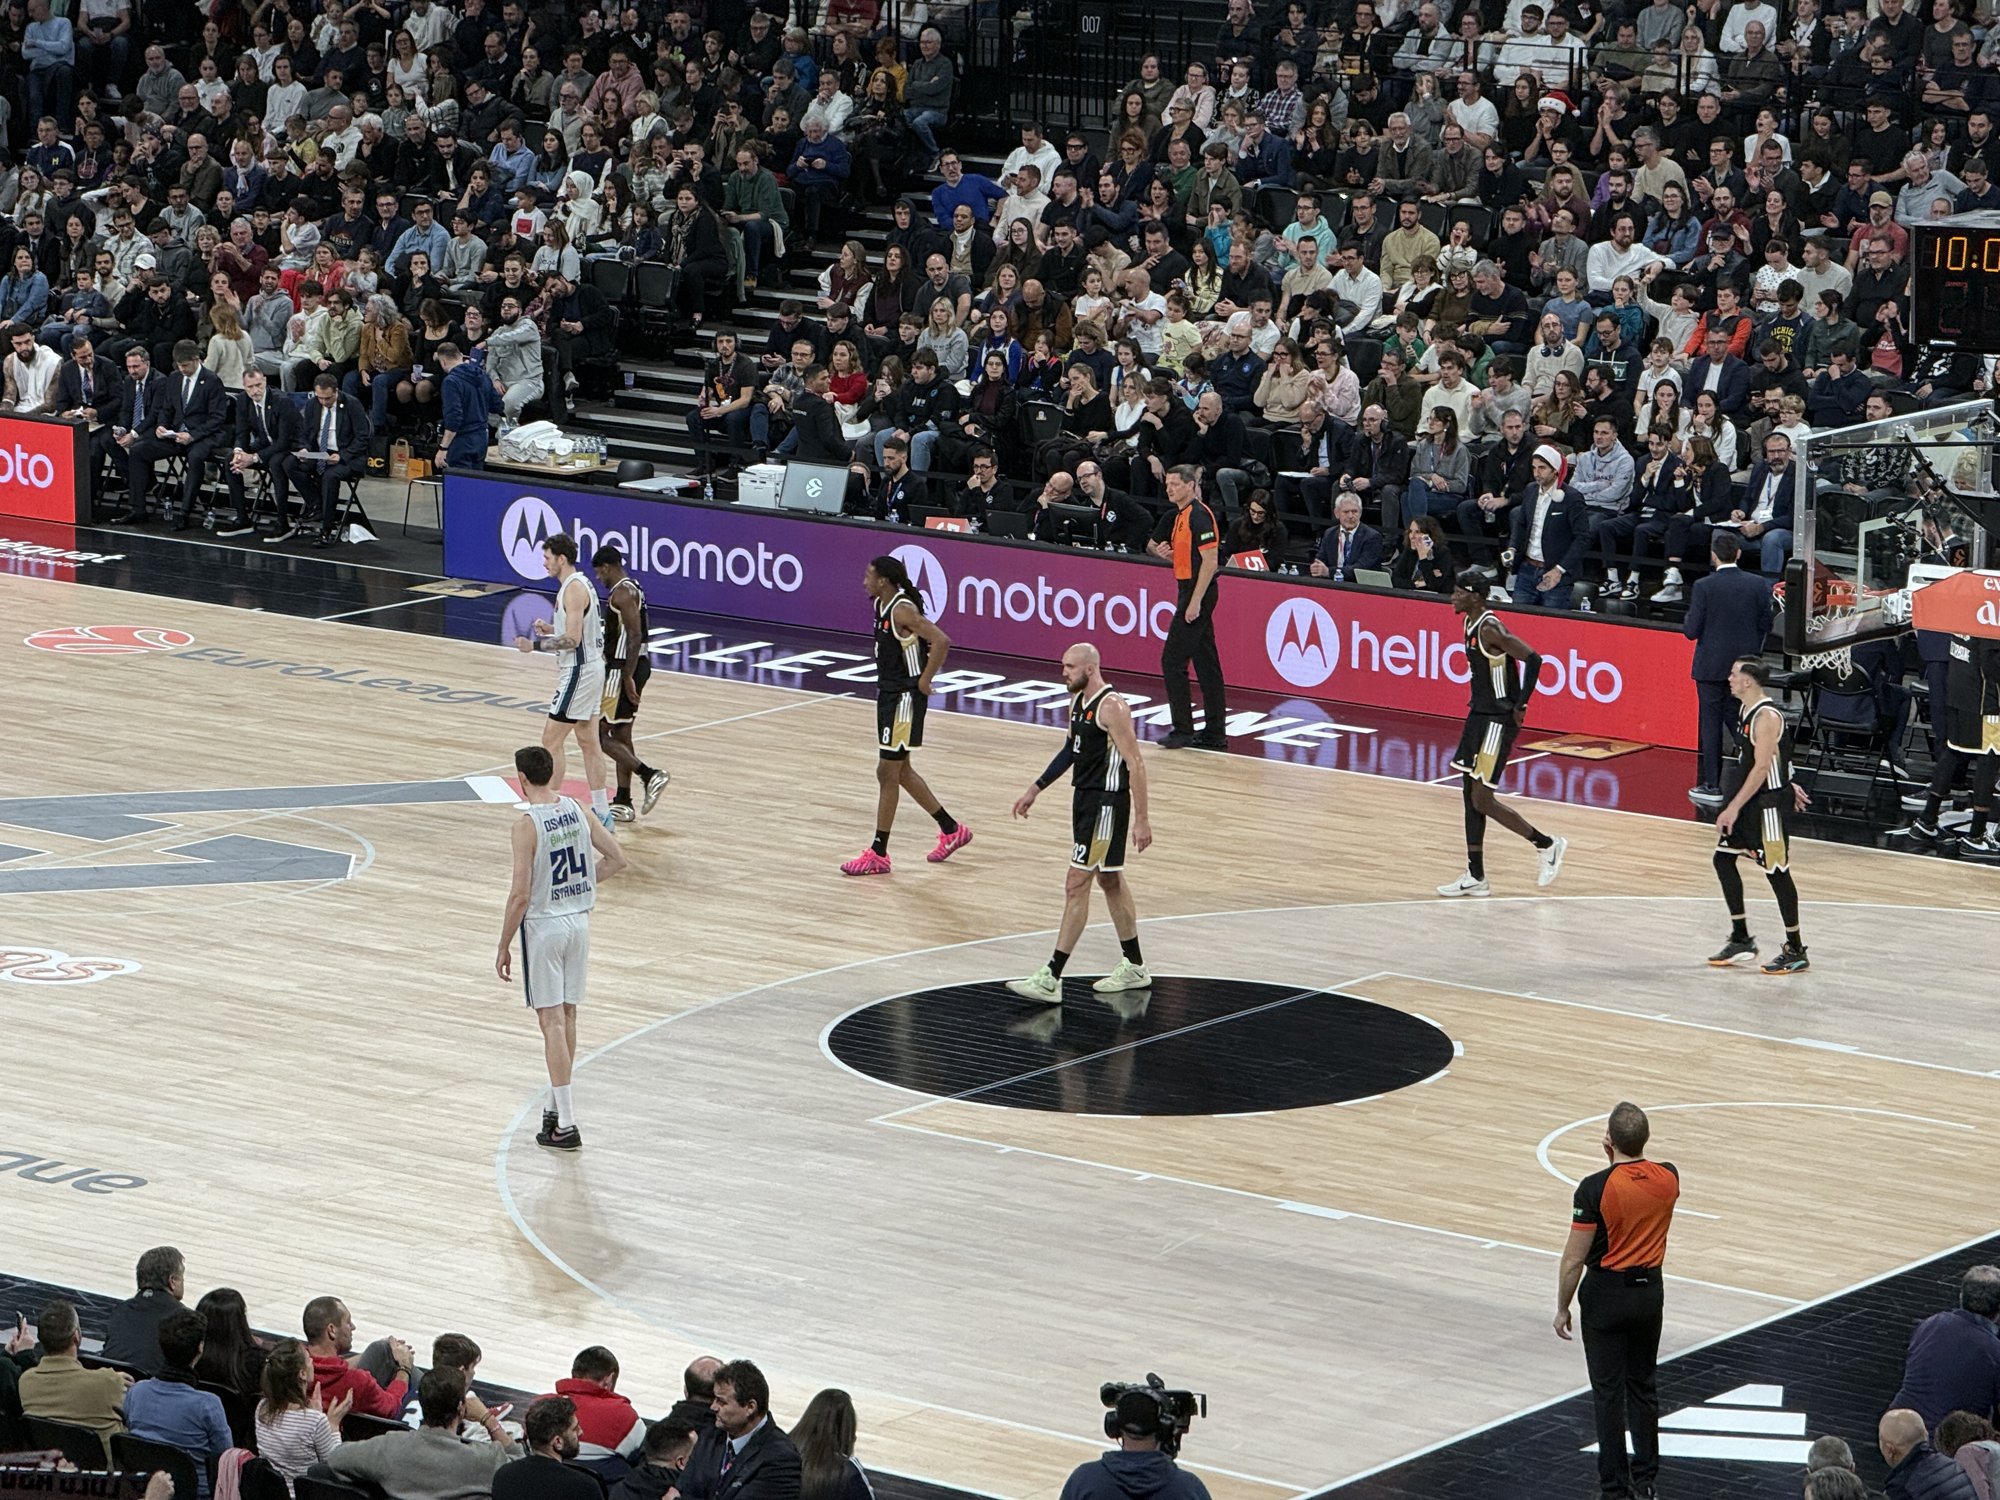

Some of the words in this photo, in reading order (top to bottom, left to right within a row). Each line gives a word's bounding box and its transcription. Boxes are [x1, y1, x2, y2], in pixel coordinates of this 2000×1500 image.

[1082, 15, 1101, 33] 007
[574, 518, 803, 592] hellomoto
[1351, 620, 1623, 704] hellooto
[882, 727, 890, 744] 8
[543, 811, 580, 832] OSMANI
[550, 846, 587, 886] 24
